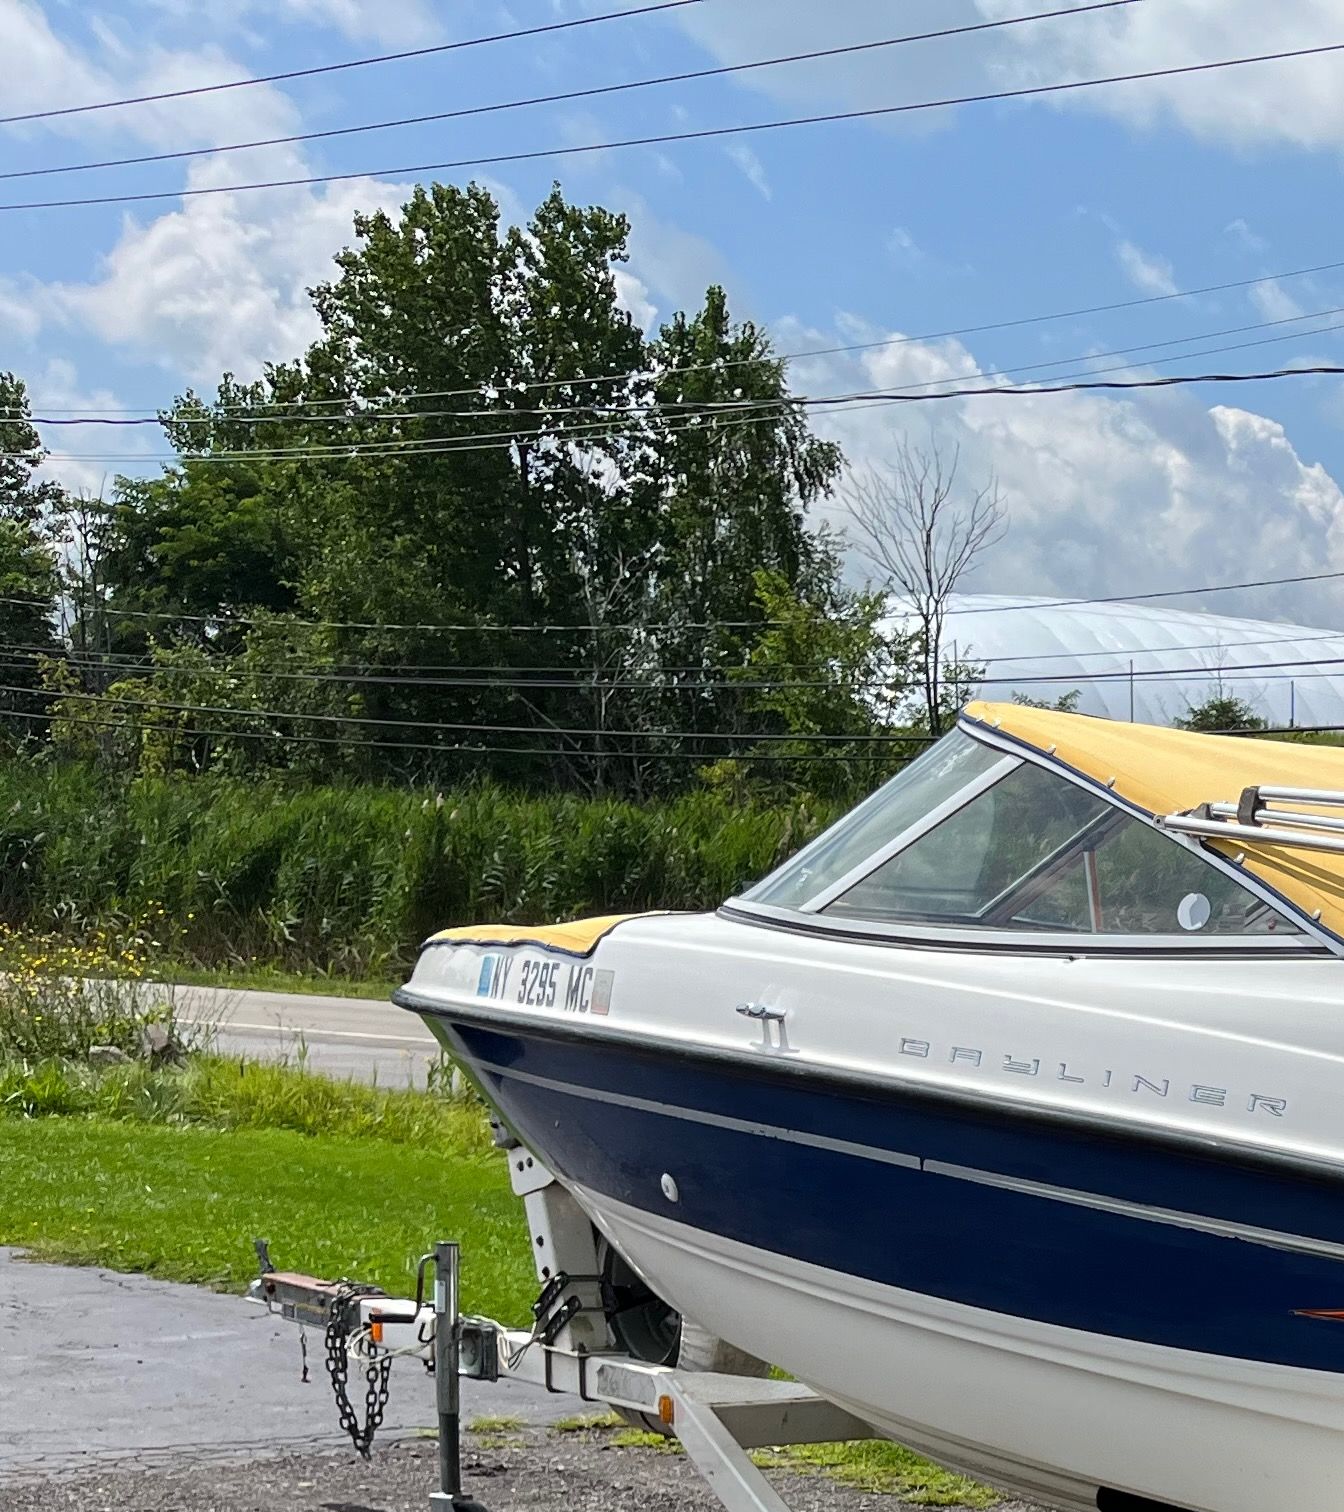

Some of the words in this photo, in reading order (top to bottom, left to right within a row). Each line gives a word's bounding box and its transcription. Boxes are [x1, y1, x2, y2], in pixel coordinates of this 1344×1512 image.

[491, 956, 513, 999] NY
[517, 959, 560, 1006] 3295
[564, 965, 593, 1012] MC
[899, 1037, 1287, 1117] BAYLINER
